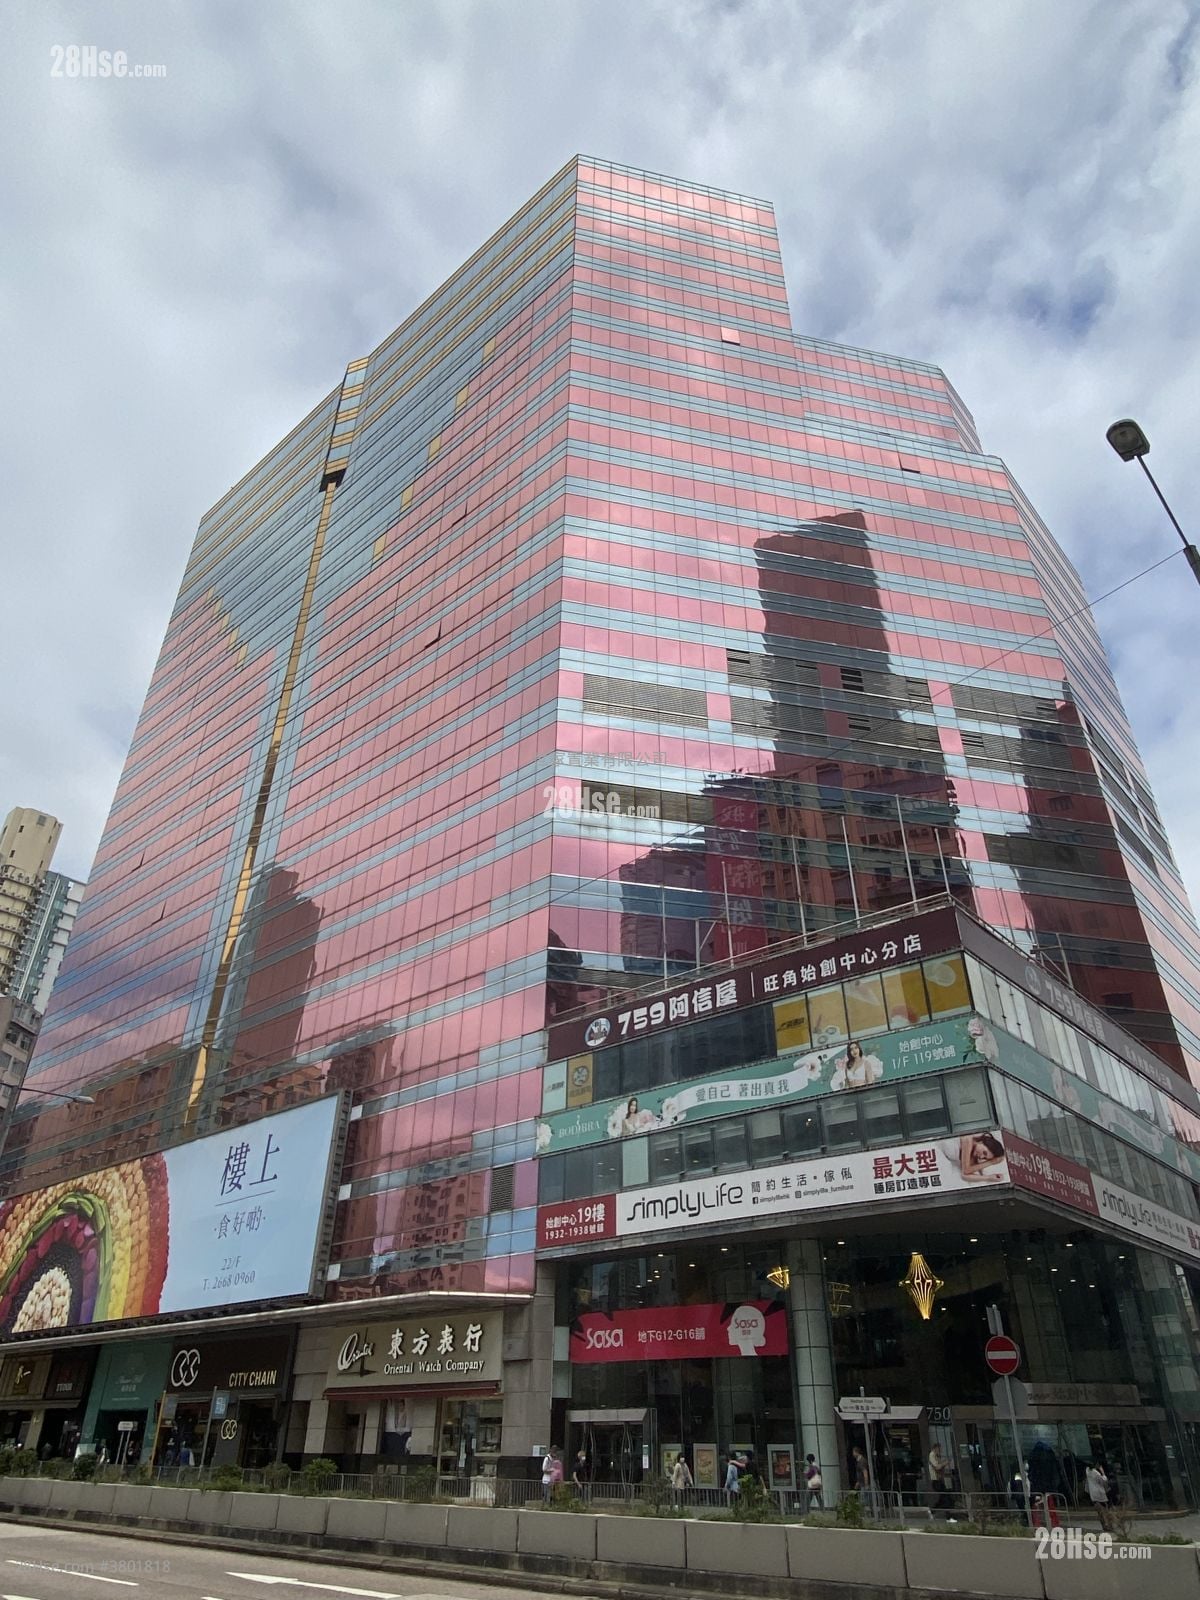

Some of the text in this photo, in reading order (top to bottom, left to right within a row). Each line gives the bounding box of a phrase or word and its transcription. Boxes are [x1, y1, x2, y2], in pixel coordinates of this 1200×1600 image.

[618, 934, 922, 1035] 759阿信屋 旺角始創中心分店
[220, 1134, 280, 1196] 樓上
[872, 1148, 939, 1180] 最大型
[873, 1175, 942, 1195] 睡房訂造專區
[388, 1324, 483, 1359] 東方表行
[228, 1370, 277, 1387] CITY CHAIN
[384, 1359, 484, 1375] Oriental Watch Company
[926, 1406, 951, 1421] 750
